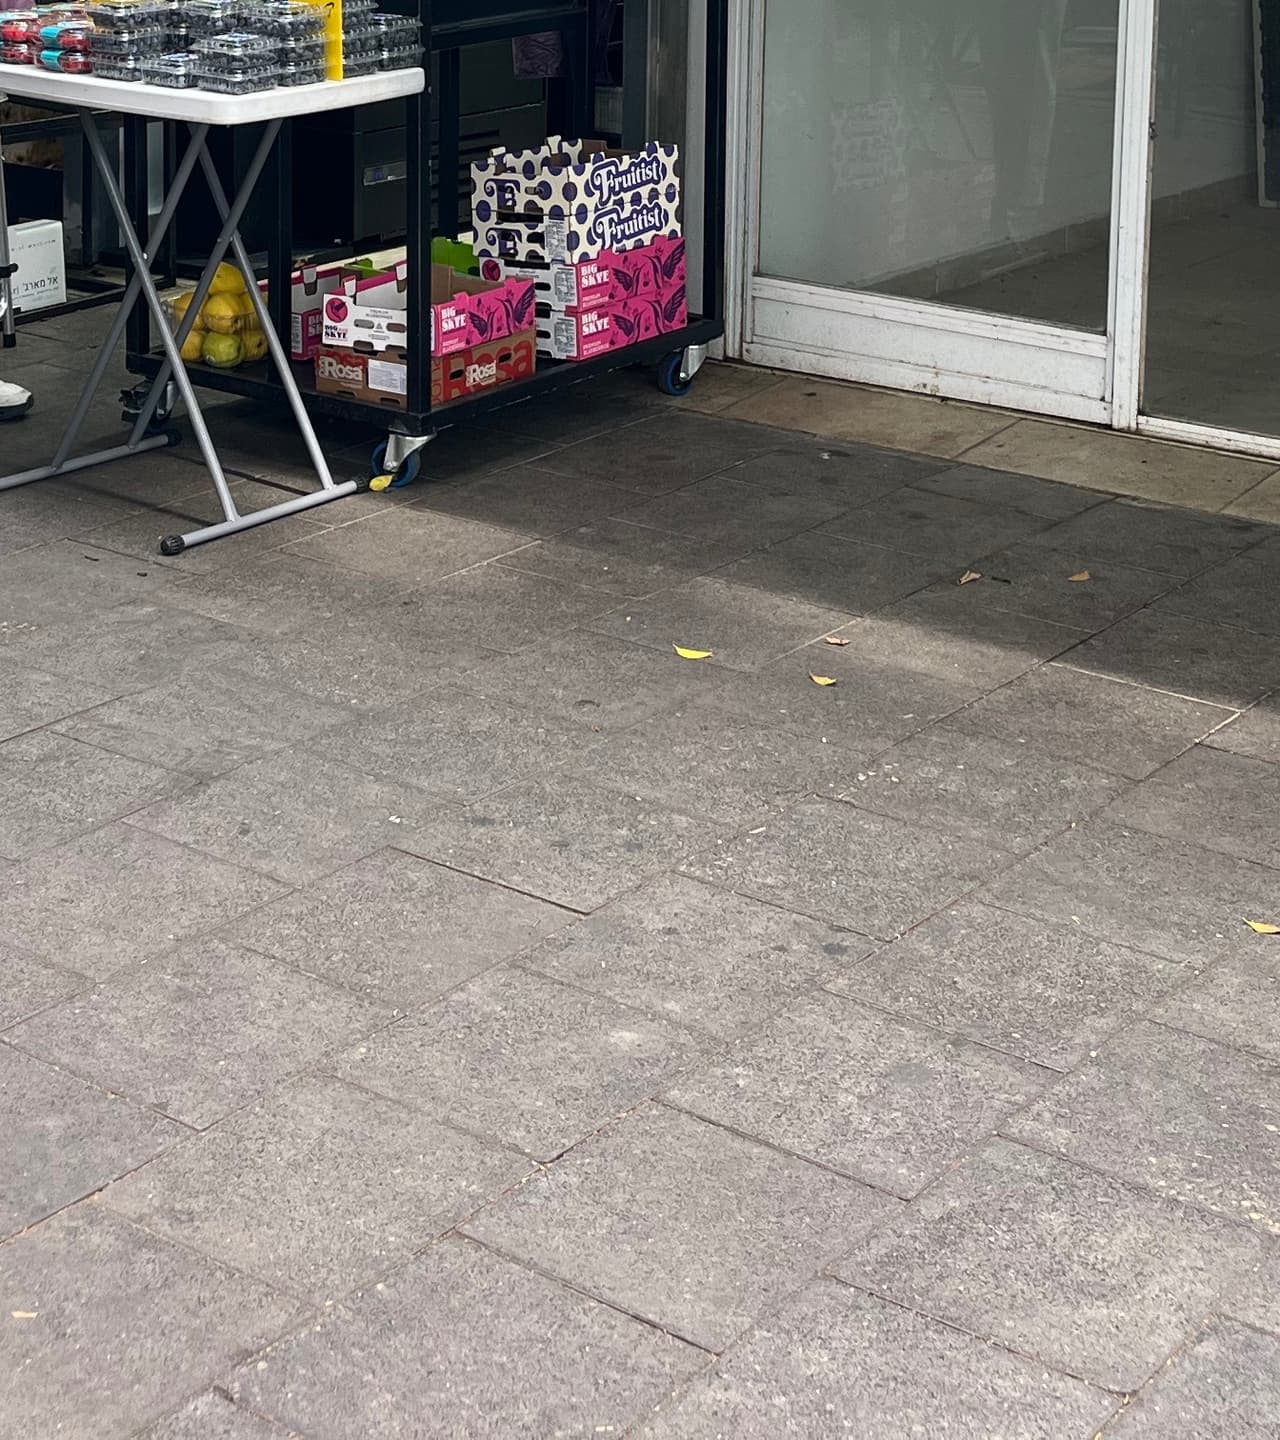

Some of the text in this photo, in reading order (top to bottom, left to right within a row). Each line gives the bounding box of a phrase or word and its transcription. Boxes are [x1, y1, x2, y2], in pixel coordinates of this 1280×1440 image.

[593, 160, 661, 202] Fruitist
[595, 209, 663, 250] Fruitist
[581, 263, 598, 276] BIG
[581, 270, 609, 289] SKYE
[441, 306, 457, 320] BIG
[581, 311, 598, 324] BIG
[441, 314, 466, 333] SKYE
[582, 317, 610, 337] SKYE
[325, 357, 362, 381] Rosa
[469, 361, 497, 384] Rosa
